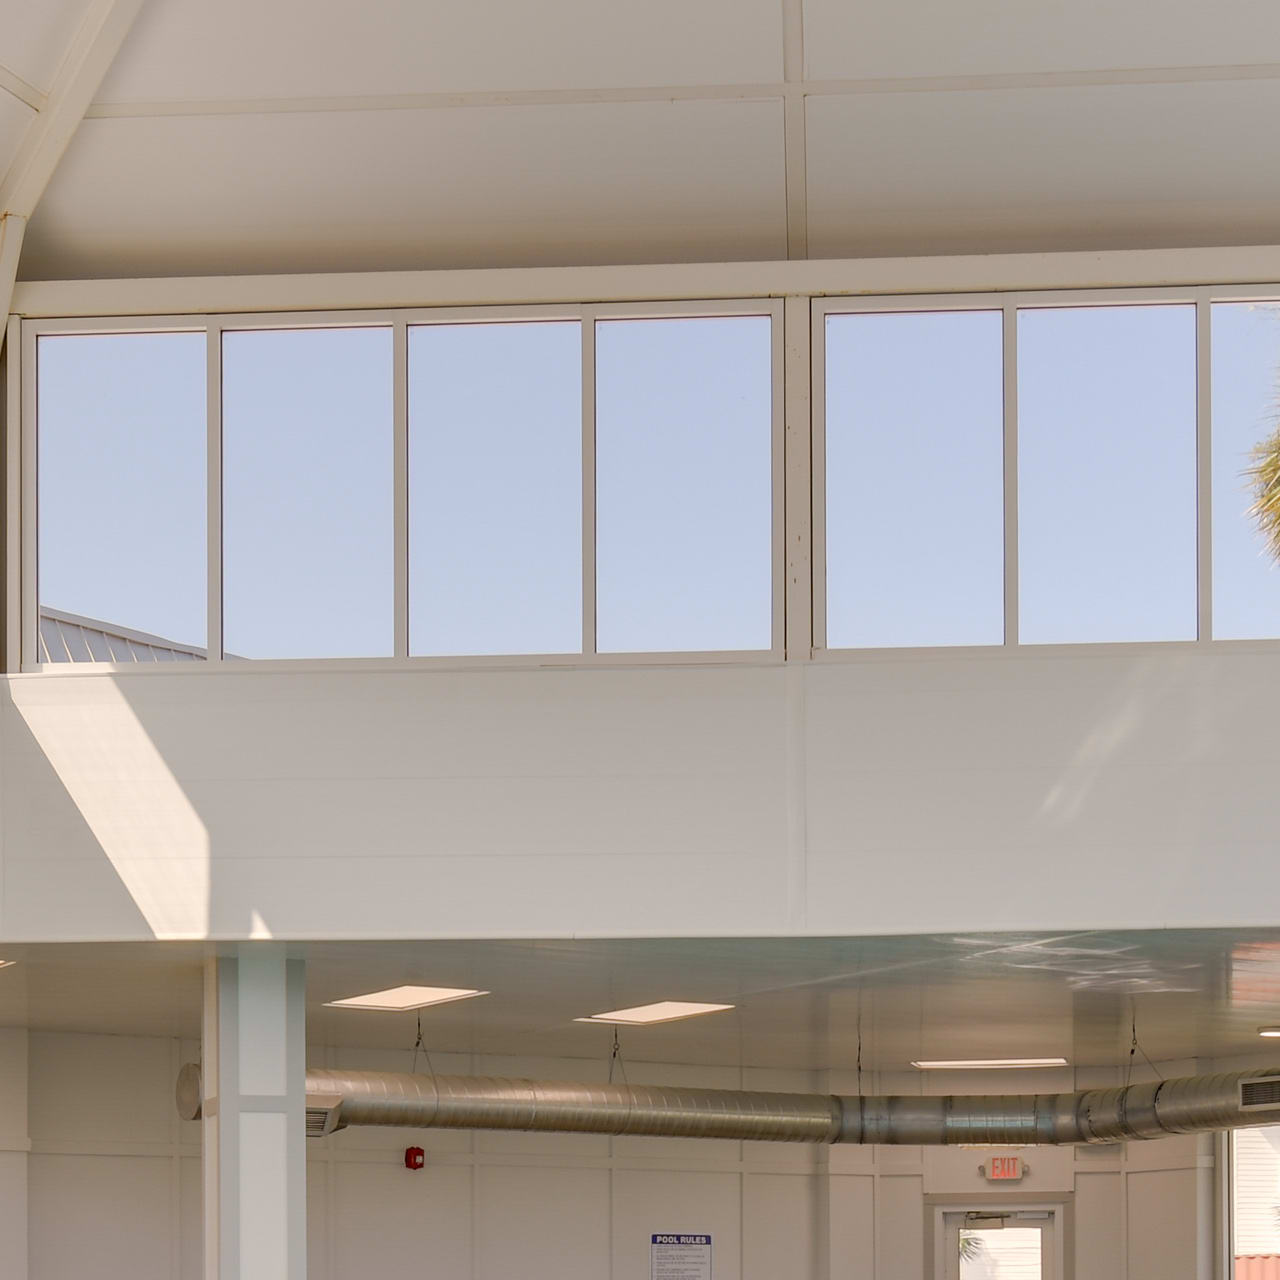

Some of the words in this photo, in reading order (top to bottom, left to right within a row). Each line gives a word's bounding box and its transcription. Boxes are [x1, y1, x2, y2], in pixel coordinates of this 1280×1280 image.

[992, 1157, 1017, 1178] EXIT
[656, 1235, 678, 1243] POOL
[680, 1236, 706, 1244] RULES
